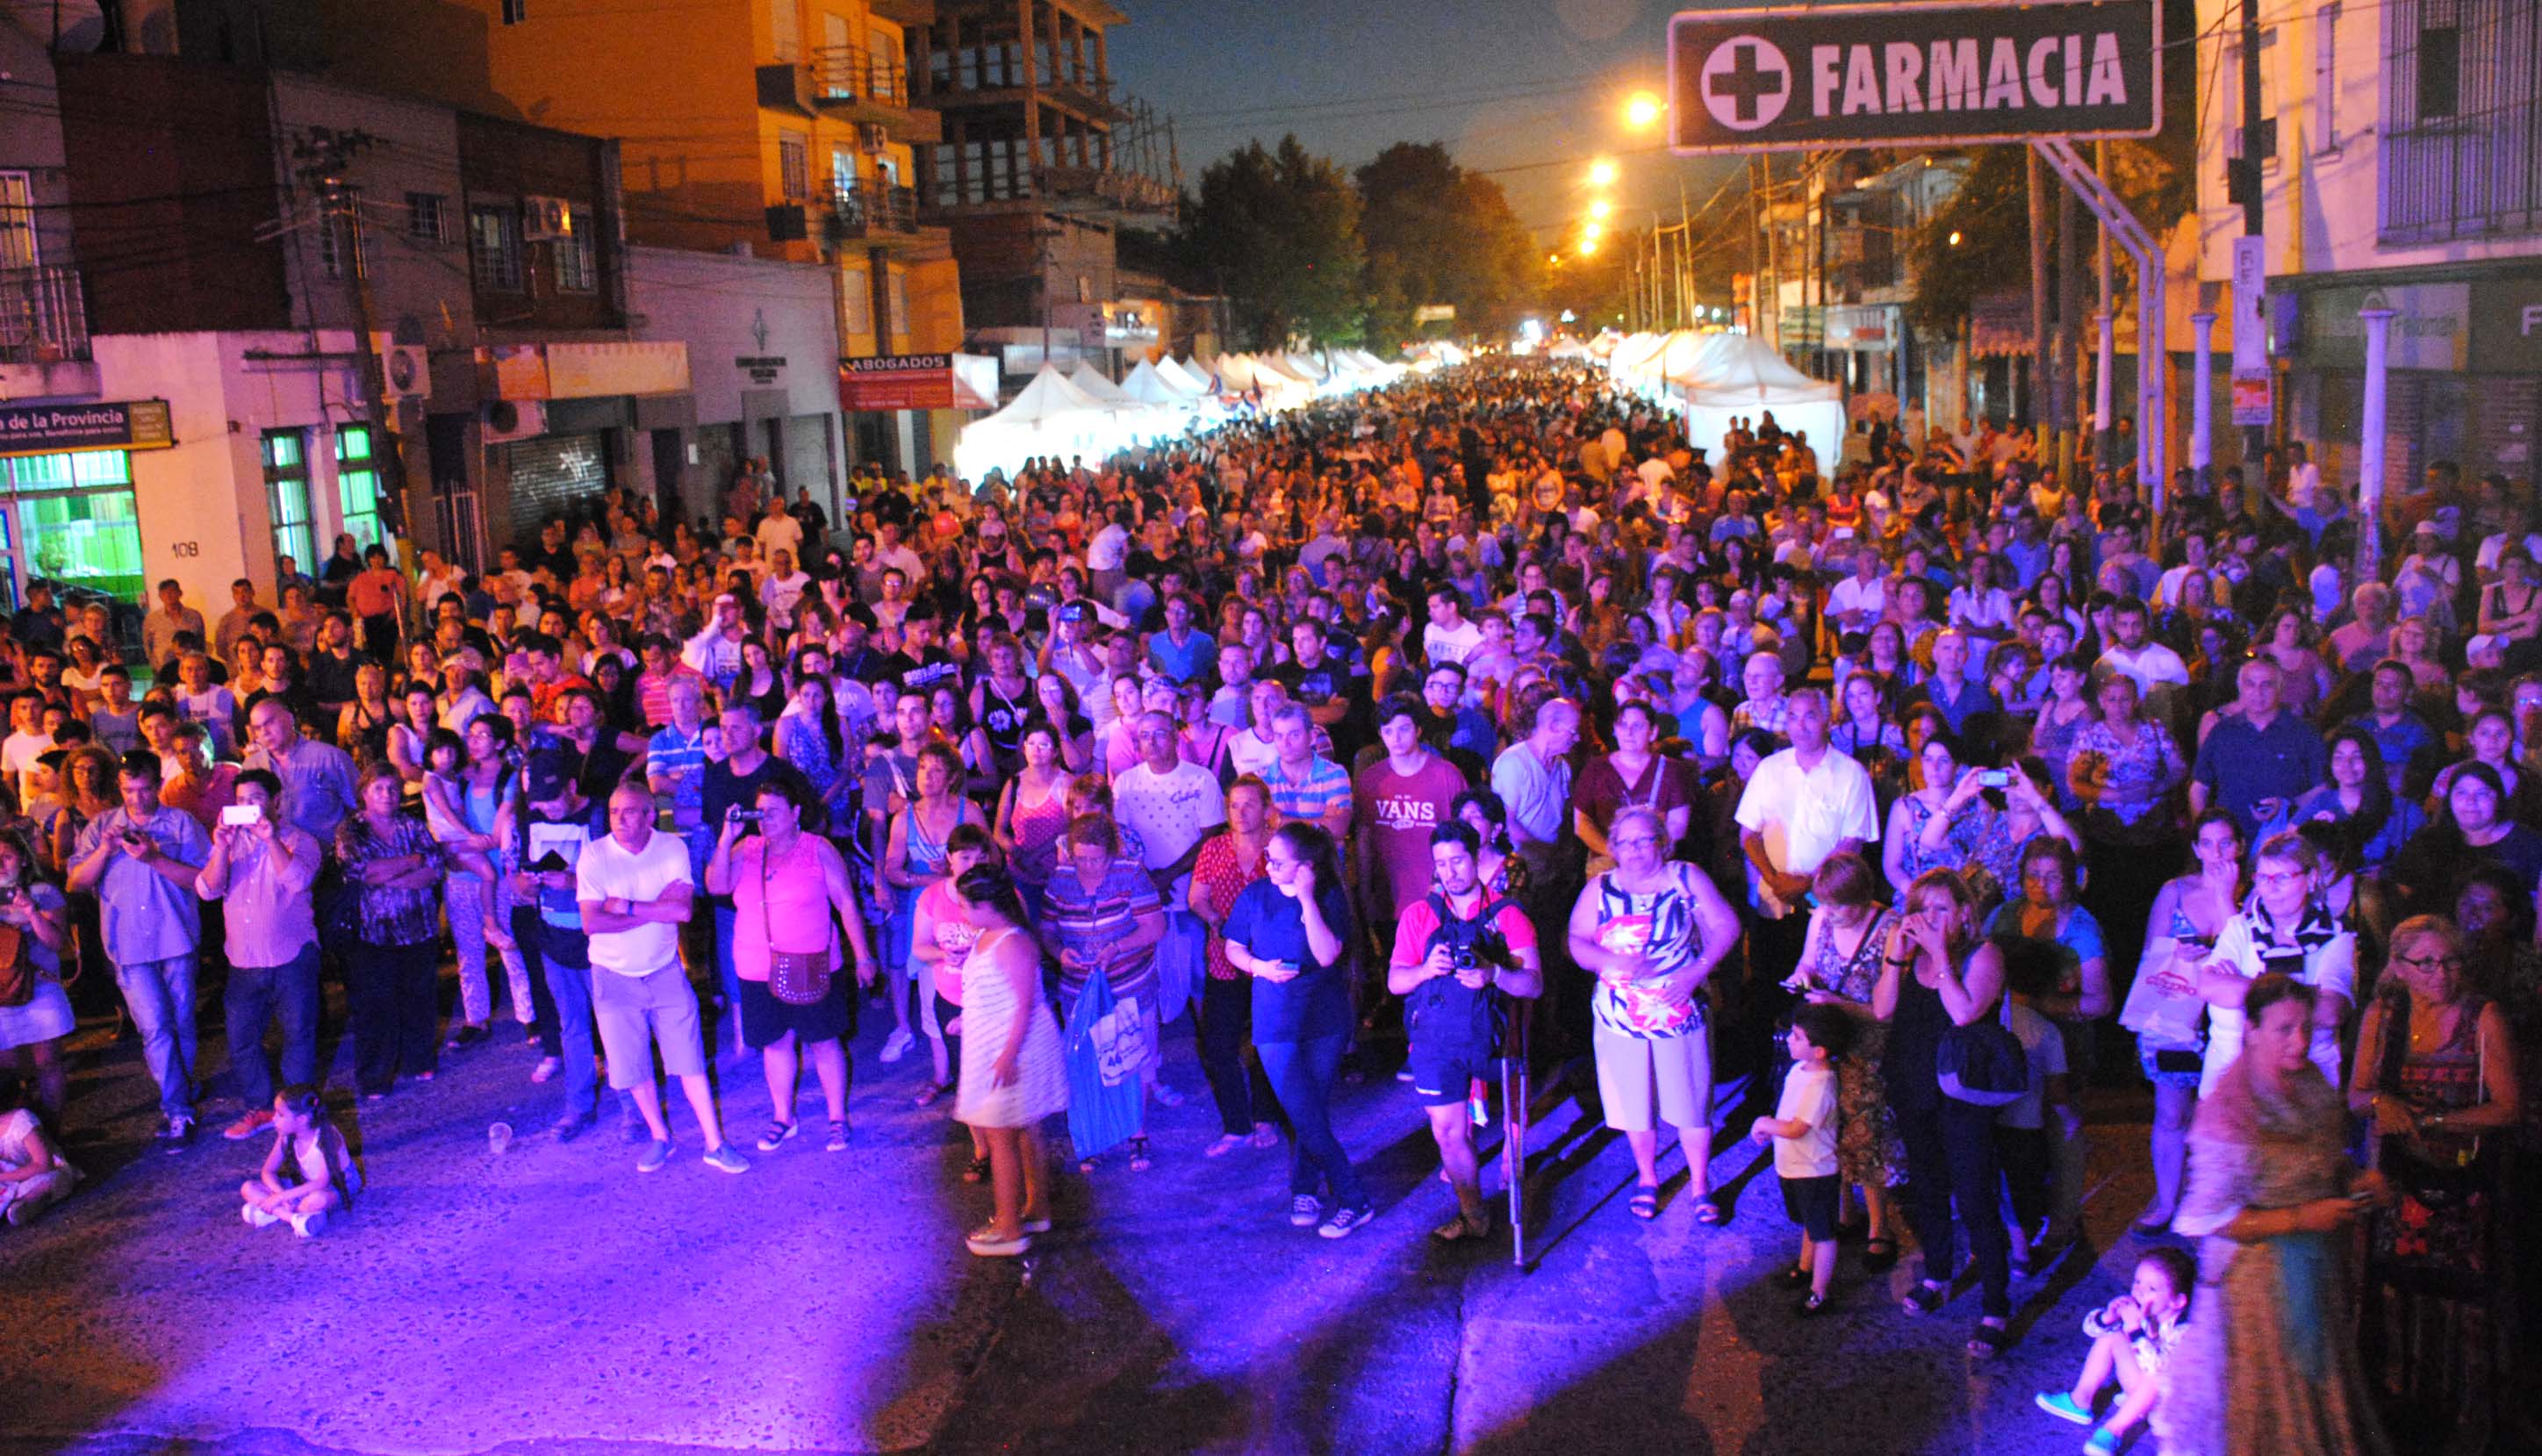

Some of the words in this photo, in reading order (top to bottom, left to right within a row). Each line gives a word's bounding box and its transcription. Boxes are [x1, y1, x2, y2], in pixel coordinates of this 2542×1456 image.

[1811, 32, 2128, 118] FARMACIA
[853, 356, 945, 370] ABOGADOS
[8, 413, 29, 429] de
[32, 412, 47, 428] la
[51, 409, 124, 427] Provincia
[171, 542, 198, 559] 108
[1375, 800, 1435, 821] VANS
